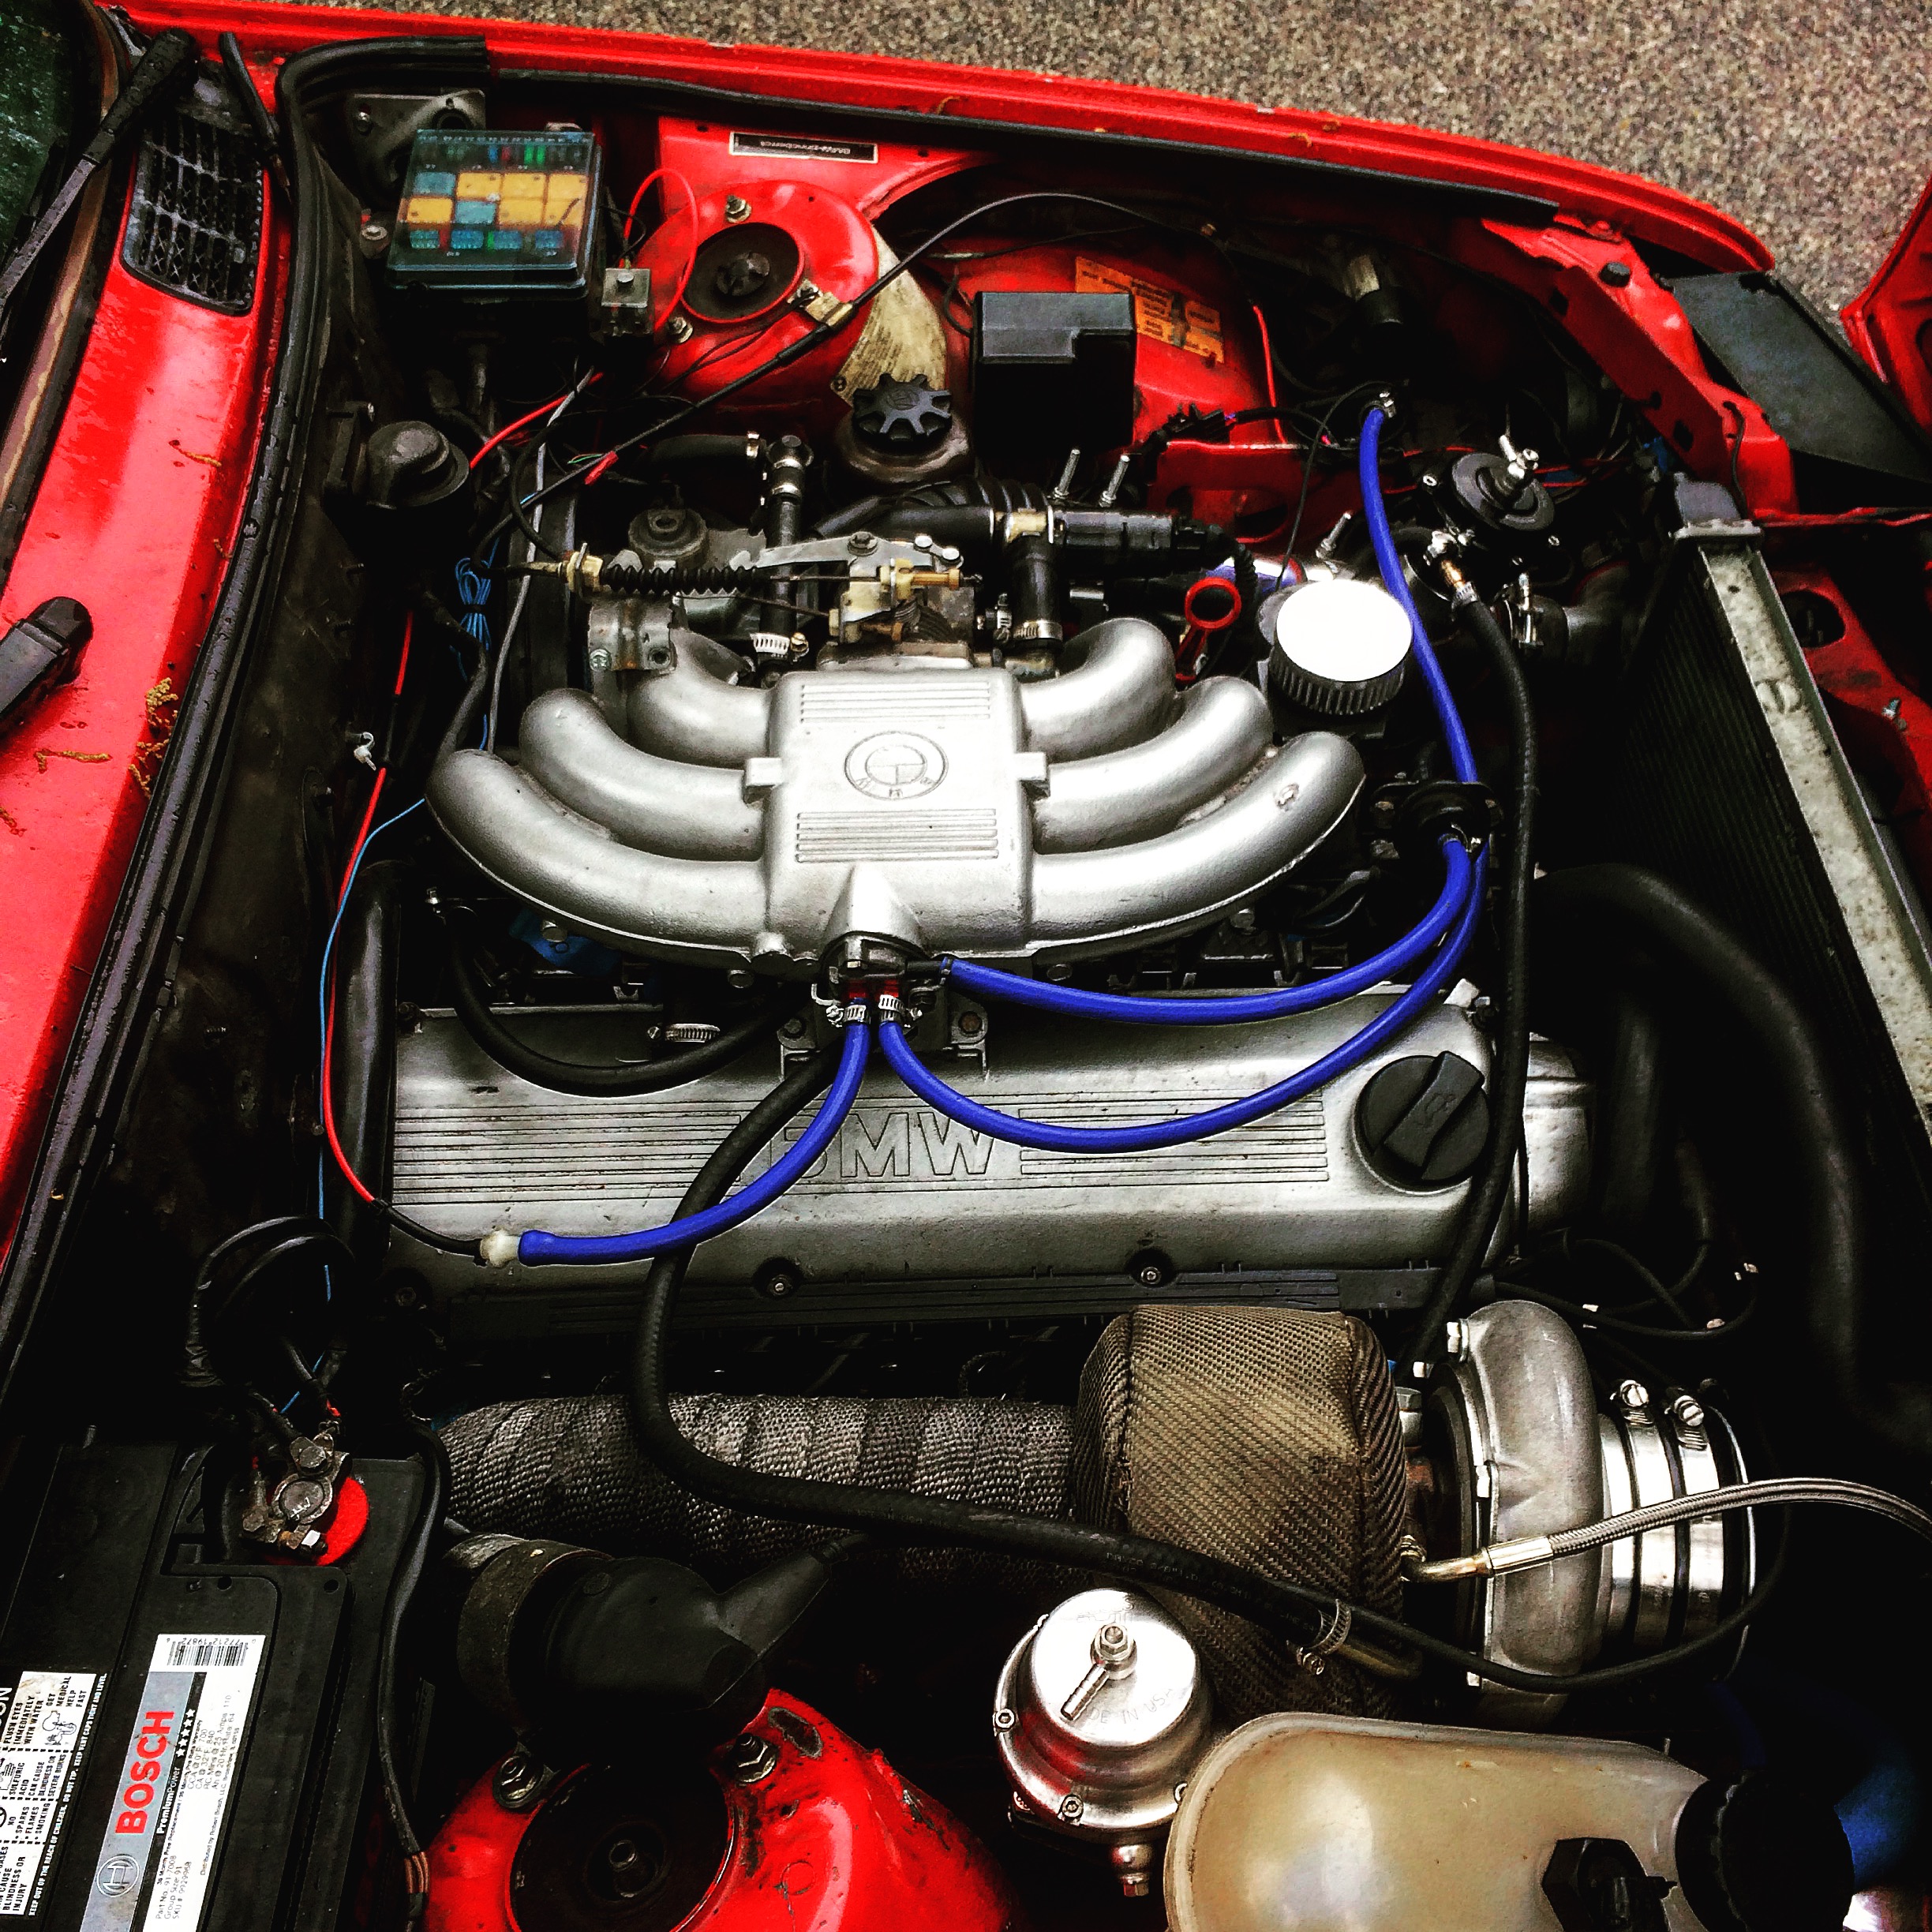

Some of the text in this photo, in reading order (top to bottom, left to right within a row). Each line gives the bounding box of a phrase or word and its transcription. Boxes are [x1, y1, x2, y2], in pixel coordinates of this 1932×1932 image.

[45, 1693, 56, 1706] GET
[55, 1676, 72, 1707] MEDICAL
[66, 1690, 77, 1707] HELP
[75, 1690, 87, 1708] FAST
[223, 1694, 231, 1708] 110
[2, 1722, 17, 1744] FLUSH
[11, 1702, 24, 1720] EYES
[13, 1695, 36, 1745] IMMEDIATELY
[23, 1700, 44, 1745] WITH WATER
[82, 1720, 93, 1735] CAPS
[187, 1771, 198, 1789] CCA
[198, 1728, 208, 1743] 700
[195, 1777, 204, 1789] CA
[206, 1730, 215, 1744] 840
[9, 1762, 25, 1795] SULFURIC
[28, 1762, 45, 1796] CAN CAUSE
[37, 1755, 57, 1796] BLINDNESS OR
[47, 1754, 66, 1797] SEVERE BURNS
[115, 1711, 174, 1833] BOSCH
[18, 1779, 29, 1795] ACID
[7, 1816, 17, 1825] NO
[15, 1807, 30, 1833] SPARKS
[24, 1807, 39, 1834] FLAMES
[35, 1803, 51, 1834] SMOKING
[50, 1835, 58, 1844] OF
[43, 1844, 56, 1864] REACH
[2, 1856, 26, 1911] BLINDNESS OR
[37, 1878, 46, 1886] OF
[39, 1865, 50, 1877] THE
[12, 1883, 28, 1911] INJURY
[33, 1886, 43, 1899] OUT
[163, 1895, 176, 1919] Group
[174, 1866, 183, 1875] 91
[28, 1900, 39, 1916] KEEP
[155, 1904, 166, 1919] Part
[172, 1904, 182, 1919] SKU
